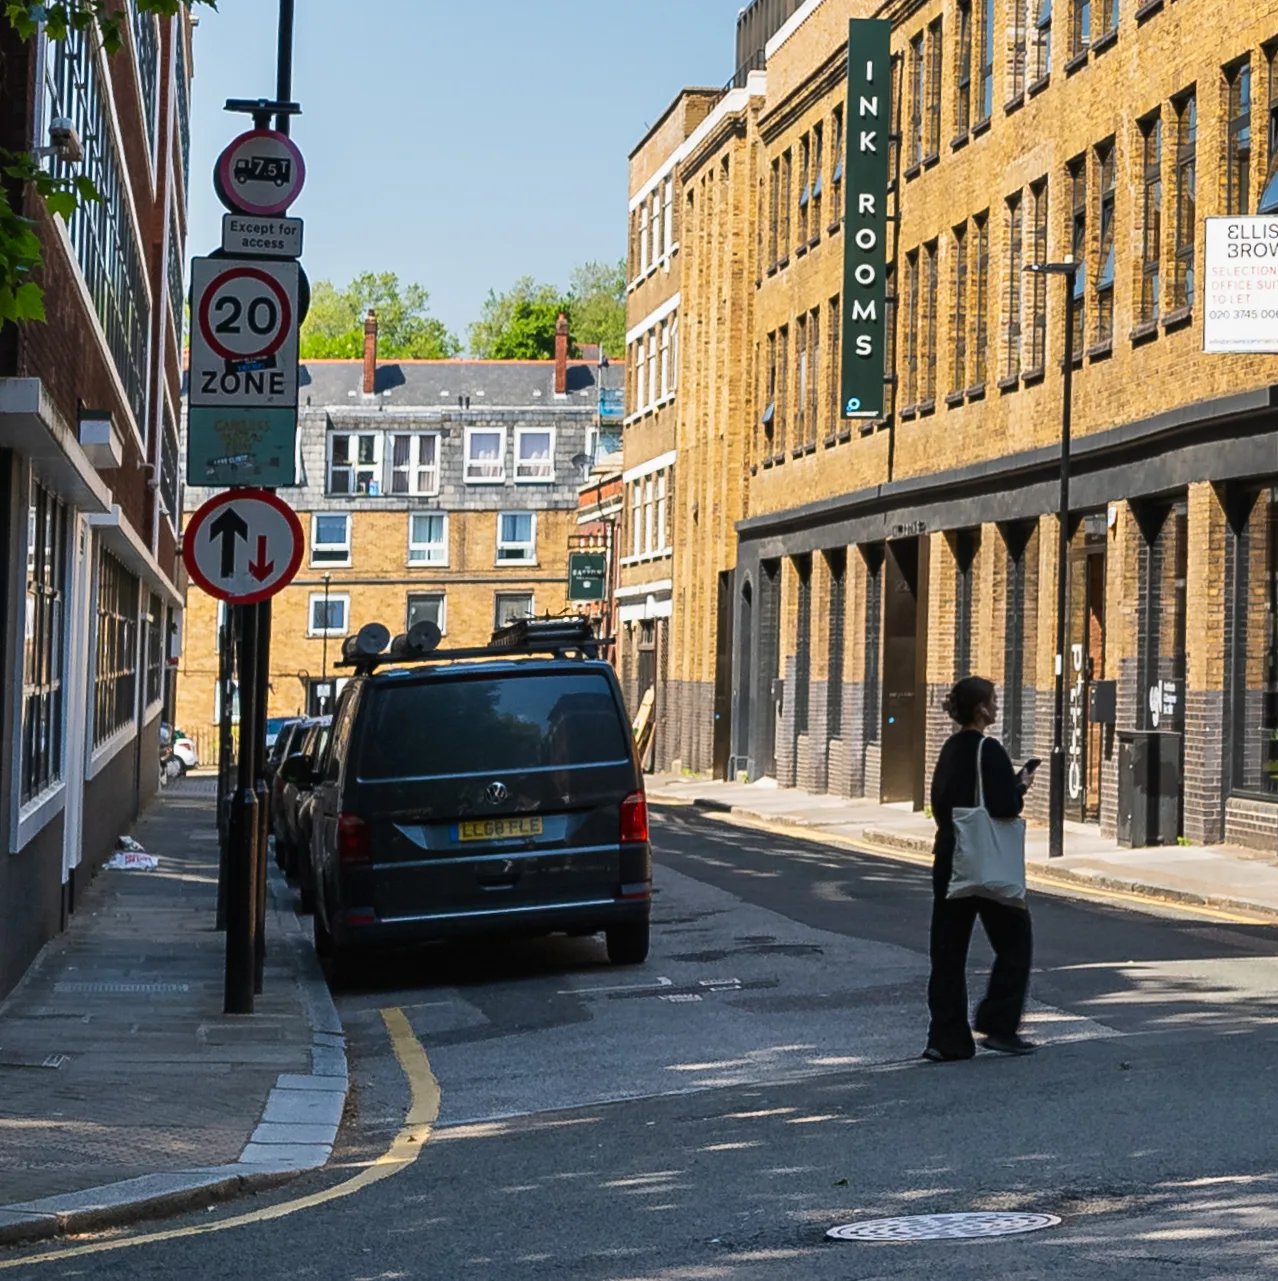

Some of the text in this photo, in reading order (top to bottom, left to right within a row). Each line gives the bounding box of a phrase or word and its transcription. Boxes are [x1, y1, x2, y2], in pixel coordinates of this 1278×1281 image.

[858, 60, 879, 152] INK
[230, 220, 297, 236] Except for
[241, 237, 285, 249] access
[851, 192, 877, 356] ROOMS
[1211, 265, 1277, 276] SELECTION
[1211, 280, 1253, 291] OFFICE
[1212, 293, 1252, 305] TO LET
[214, 296, 277, 335] 20
[1209, 310, 1231, 320] 020
[1232, 309, 1258, 319] 3745
[201, 370, 285, 395] ZONE
